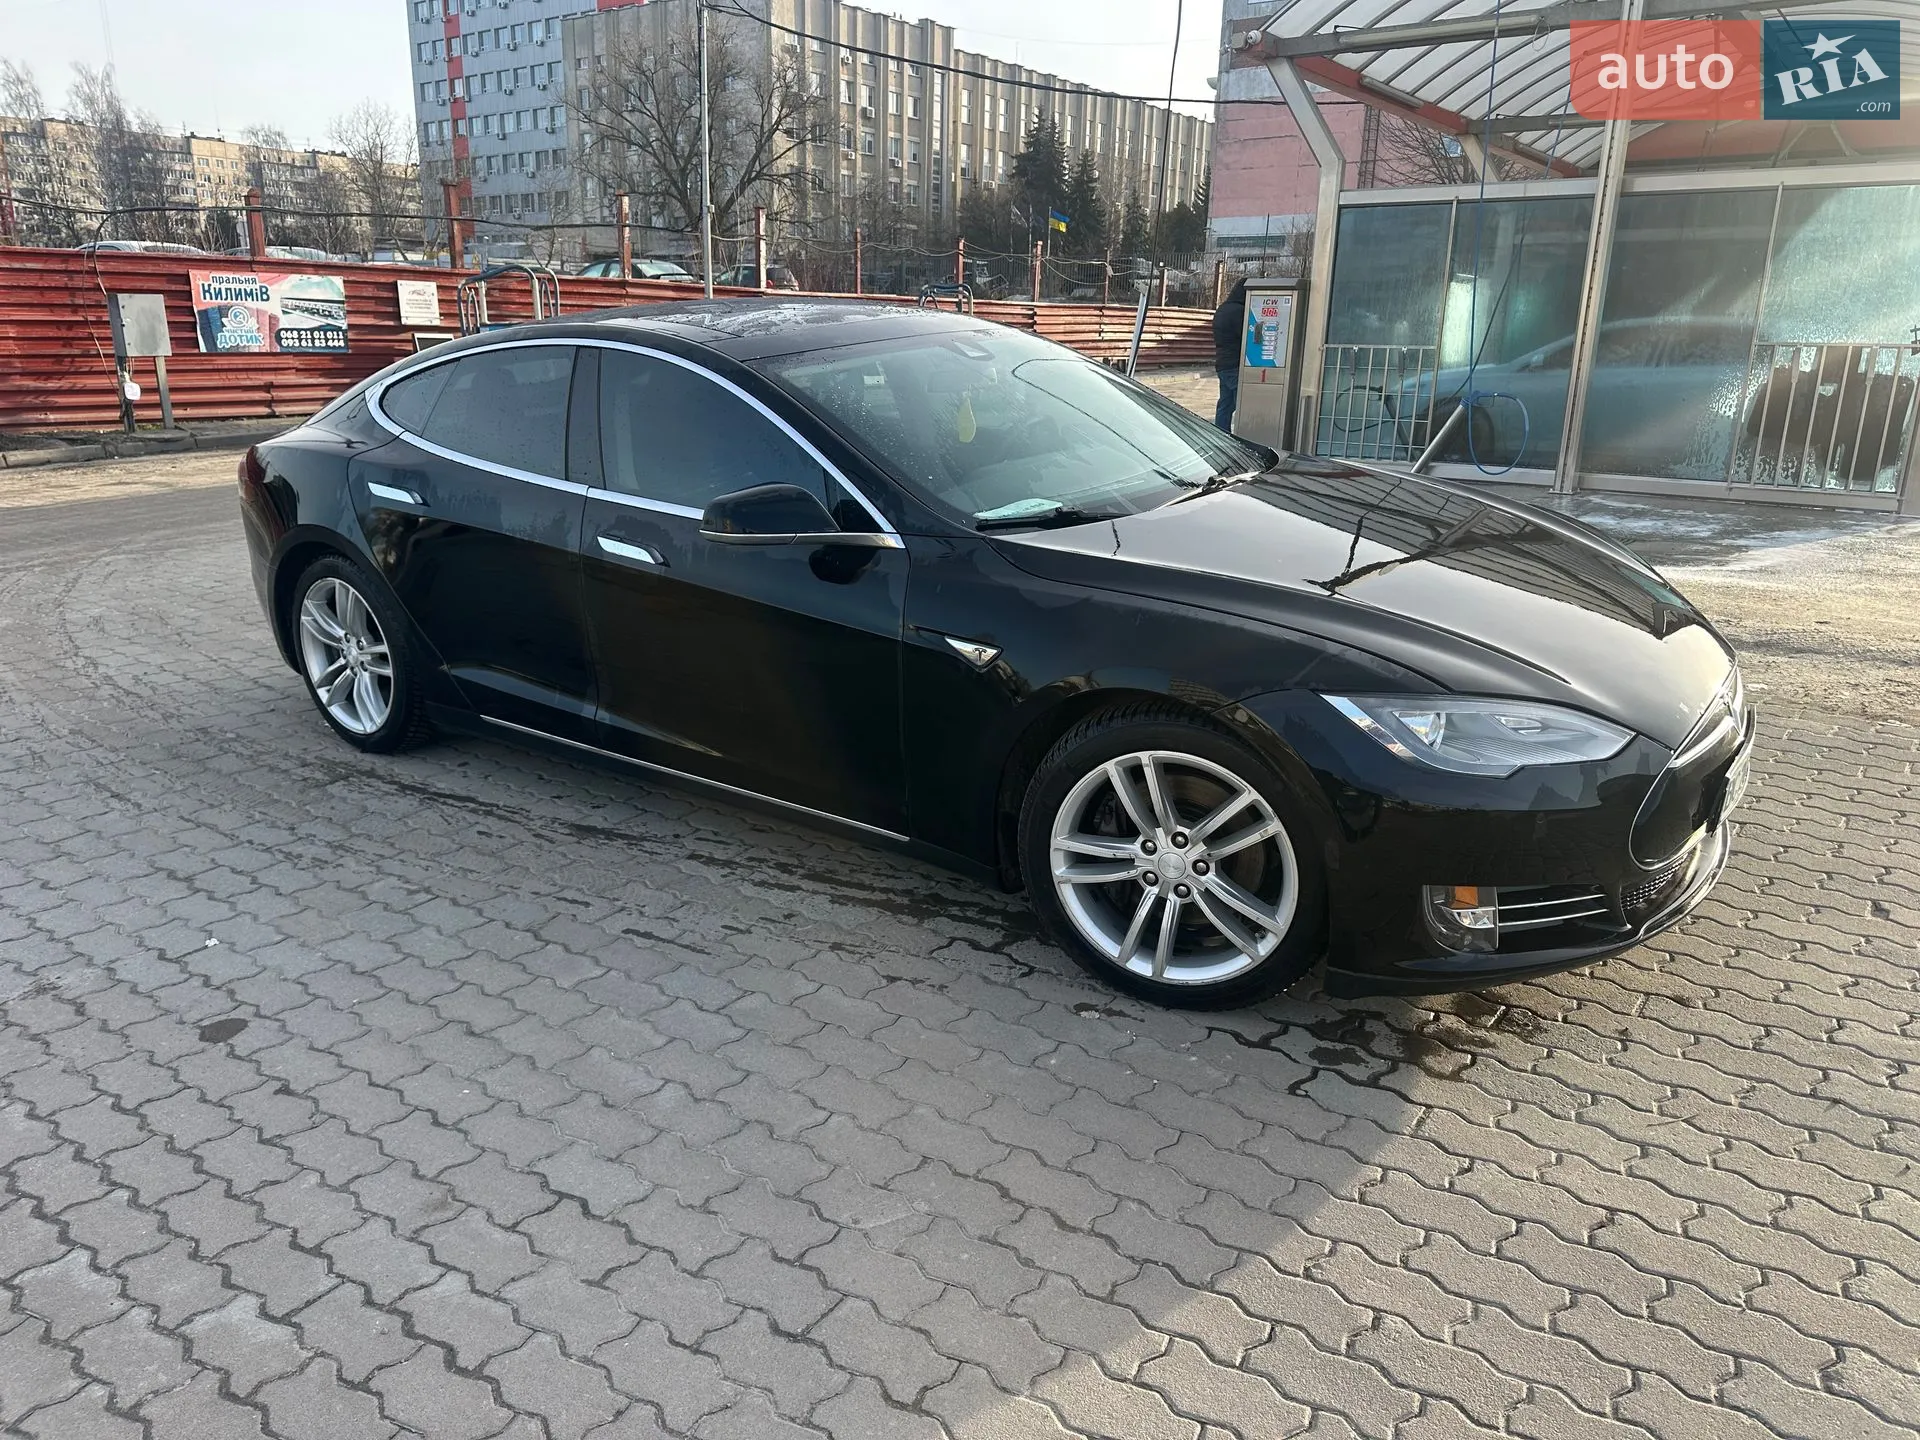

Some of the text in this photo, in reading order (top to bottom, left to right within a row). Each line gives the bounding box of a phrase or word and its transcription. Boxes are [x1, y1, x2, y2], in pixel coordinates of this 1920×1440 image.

[211, 275, 258, 285] пральня
[280, 330, 344, 339] 068 21 01 011
[281, 338, 345, 347] 093 61 83 444
[1261, 368, 1267, 382] 1
